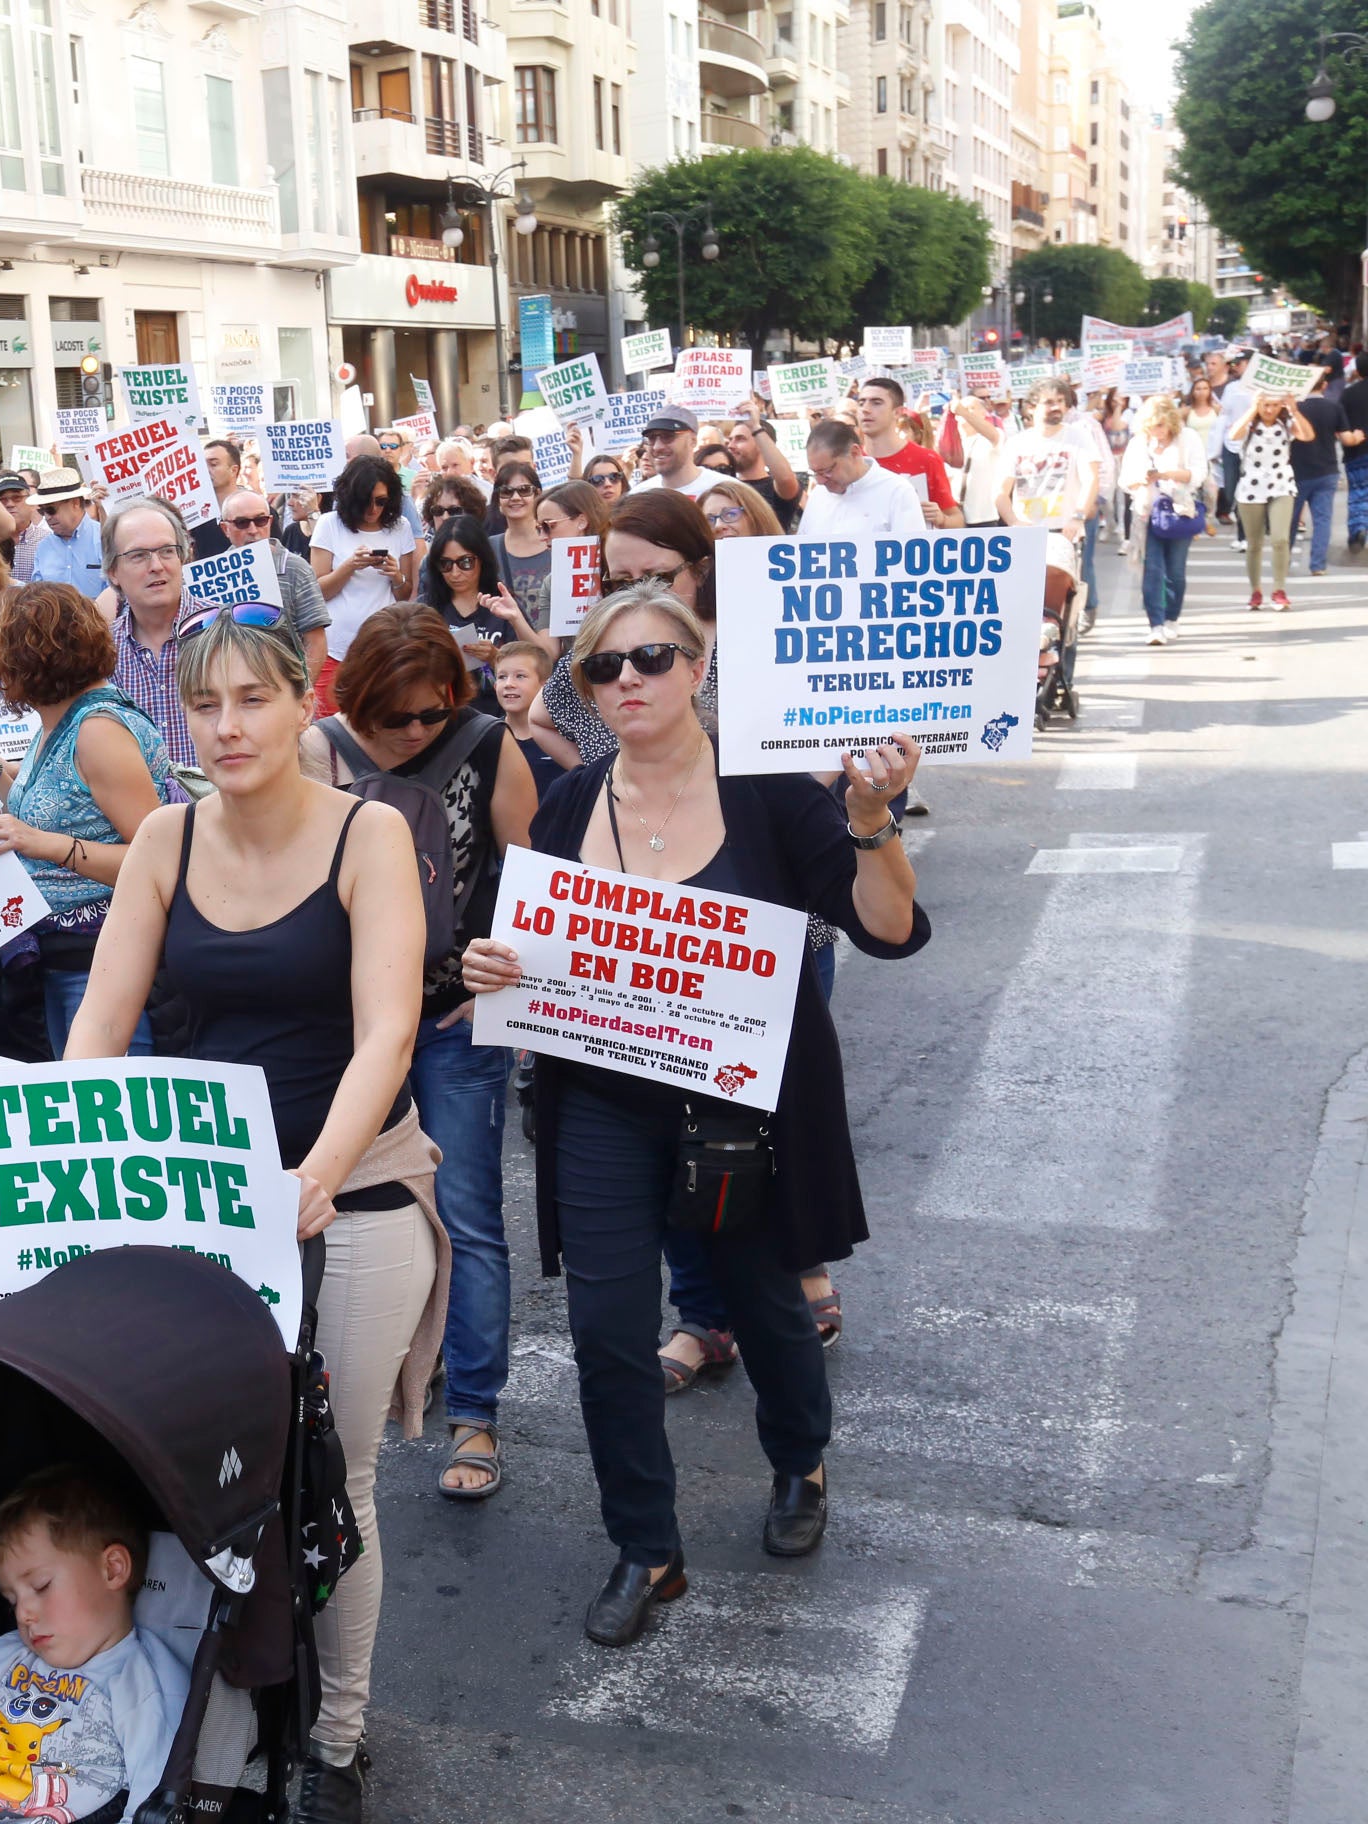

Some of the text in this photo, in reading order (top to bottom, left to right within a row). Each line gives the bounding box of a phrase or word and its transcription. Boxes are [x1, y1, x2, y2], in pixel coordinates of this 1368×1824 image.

[55, 340, 84, 351] LACOSTE
[626, 332, 664, 348] TERUEL
[629, 342, 664, 358] EXISTE
[540, 362, 592, 392] TERUEL
[776, 363, 827, 380] TERUEL
[1258, 358, 1313, 377] TERUEL
[123, 368, 188, 387] TERUEL
[698, 378, 721, 388] BOE
[780, 377, 827, 394] EXISTE
[1254, 370, 1307, 387] EXISTE
[129, 387, 188, 406] EXISTE
[211, 385, 264, 395] SER POCOS
[548, 381, 595, 409] EXISTE
[627, 390, 666, 404] POCOS
[226, 395, 261, 405] RESTA
[623, 401, 663, 415] RESTA
[74, 409, 98, 417] POCOS
[214, 405, 263, 415] DERECHOS
[60, 425, 99, 434] DERECHOS
[266, 426, 287, 437] SER
[290, 422, 332, 435] POCOS
[95, 420, 178, 462] TERUEL
[271, 435, 330, 449] NO RESTA
[272, 447, 333, 462] DERECHOS
[144, 445, 197, 491] TERUEL
[190, 549, 255, 582] POCOS
[768, 535, 1012, 581] SER POCOS
[188, 568, 254, 598] RESTA
[782, 578, 999, 622] NO RESTA
[774, 619, 1003, 665] DERECHOS
[808, 668, 973, 693] TERUEL EXISTE
[783, 702, 972, 727] #NoPierdaselTren
[761, 738, 820, 750] CORREDOR
[925, 743, 968, 755] SAGUNTO
[548, 870, 749, 935] CÚMPLASE
[512, 900, 776, 978] LO PUBLICADO
[569, 951, 705, 1000] EN BOE
[520, 975, 543, 983] mayo
[547, 978, 567, 988] 2001
[594, 987, 613, 996] julio
[632, 994, 652, 1004] 2001
[678, 1002, 686, 1010] de
[692, 1005, 725, 1018] octubre
[728, 1012, 739, 1021] de
[744, 1017, 767, 1027] 2002
[555, 988, 576, 997] 2007
[598, 997, 620, 1006] mayo
[638, 1003, 656, 1014] 2011
[669, 1009, 680, 1018] 28
[683, 1012, 716, 1026] octubre
[719, 1020, 730, 1029] de
[528, 1000, 712, 1052] #NoPierdaselTren
[506, 1020, 709, 1070] CORREDOR CANTÁBRICO-MEDITERRÁNEO
[584, 1045, 707, 1081] POR TERUEL Y SAGUNTO
[6, 1691, 60, 1722] GO
